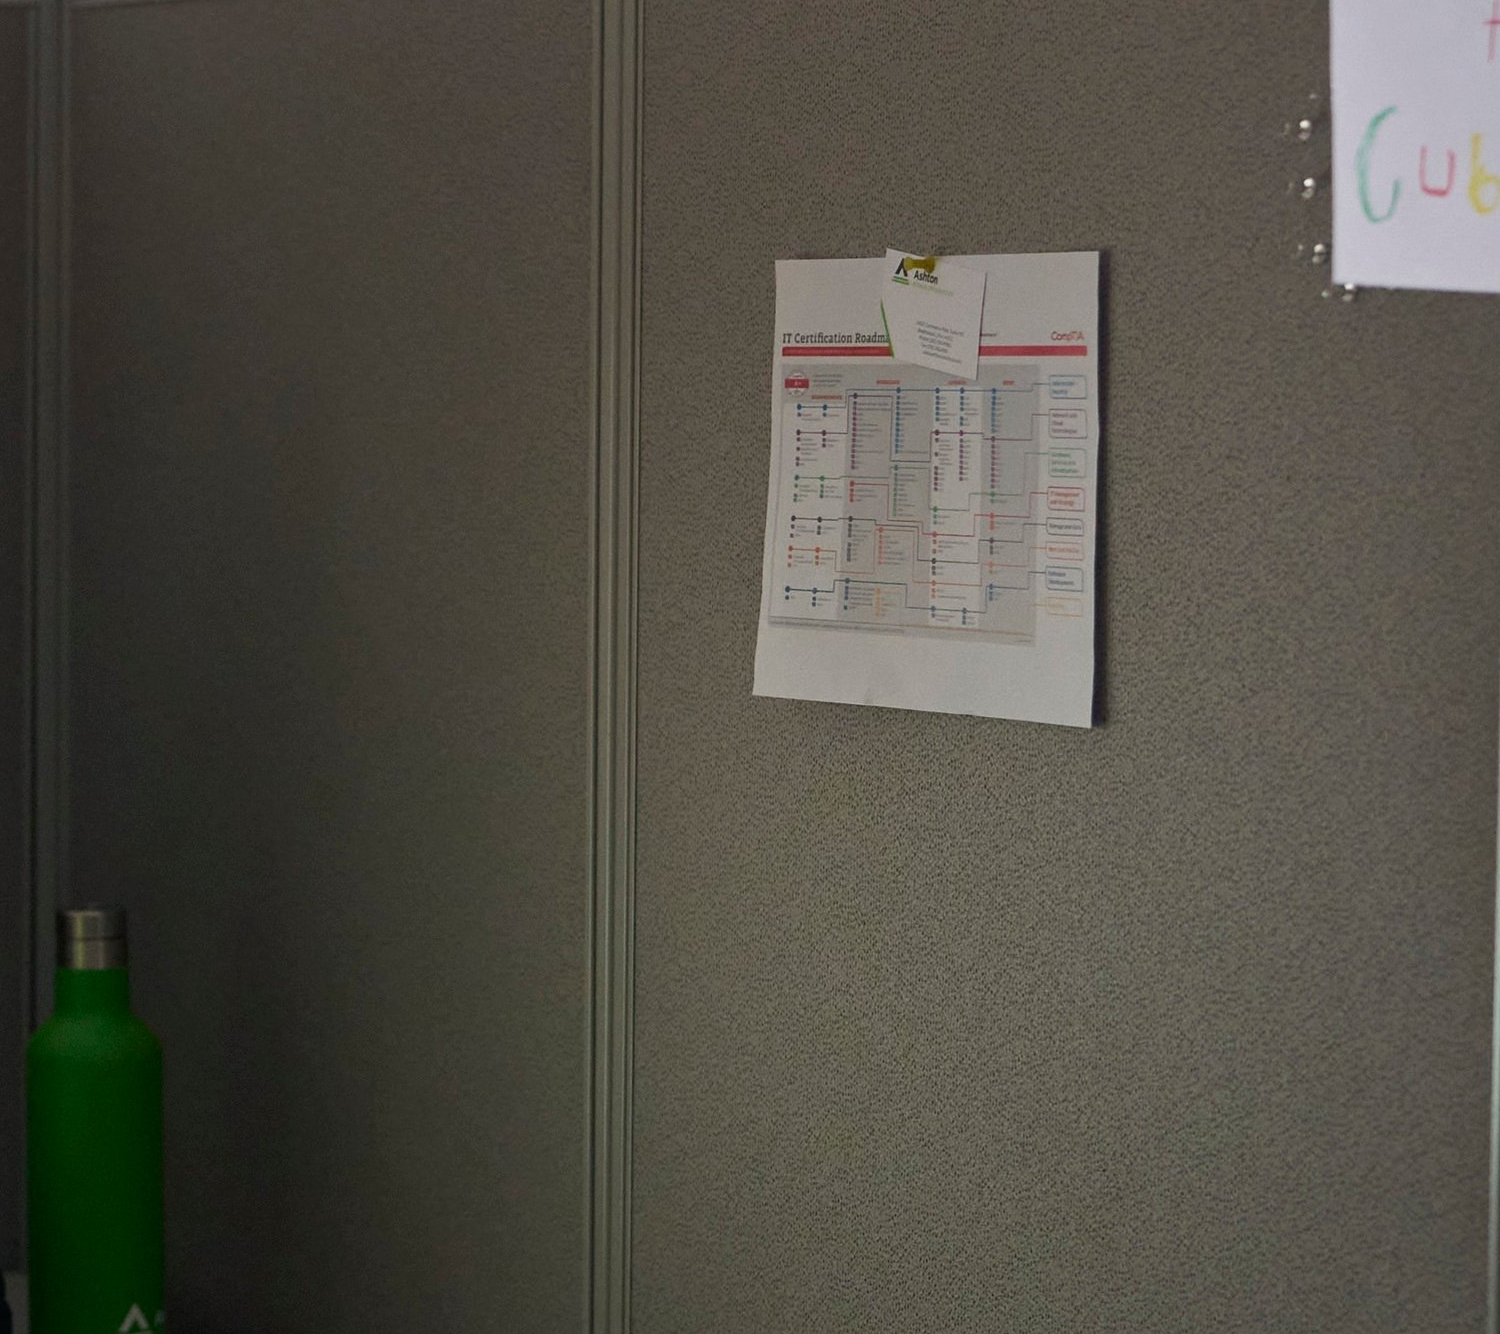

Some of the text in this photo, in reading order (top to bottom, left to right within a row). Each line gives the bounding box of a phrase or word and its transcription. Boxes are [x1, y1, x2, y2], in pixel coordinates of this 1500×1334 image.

[913, 270, 939, 285] Ashton
[782, 331, 890, 344] IT Certification Roadm
[1050, 330, 1085, 342] CompTIA
